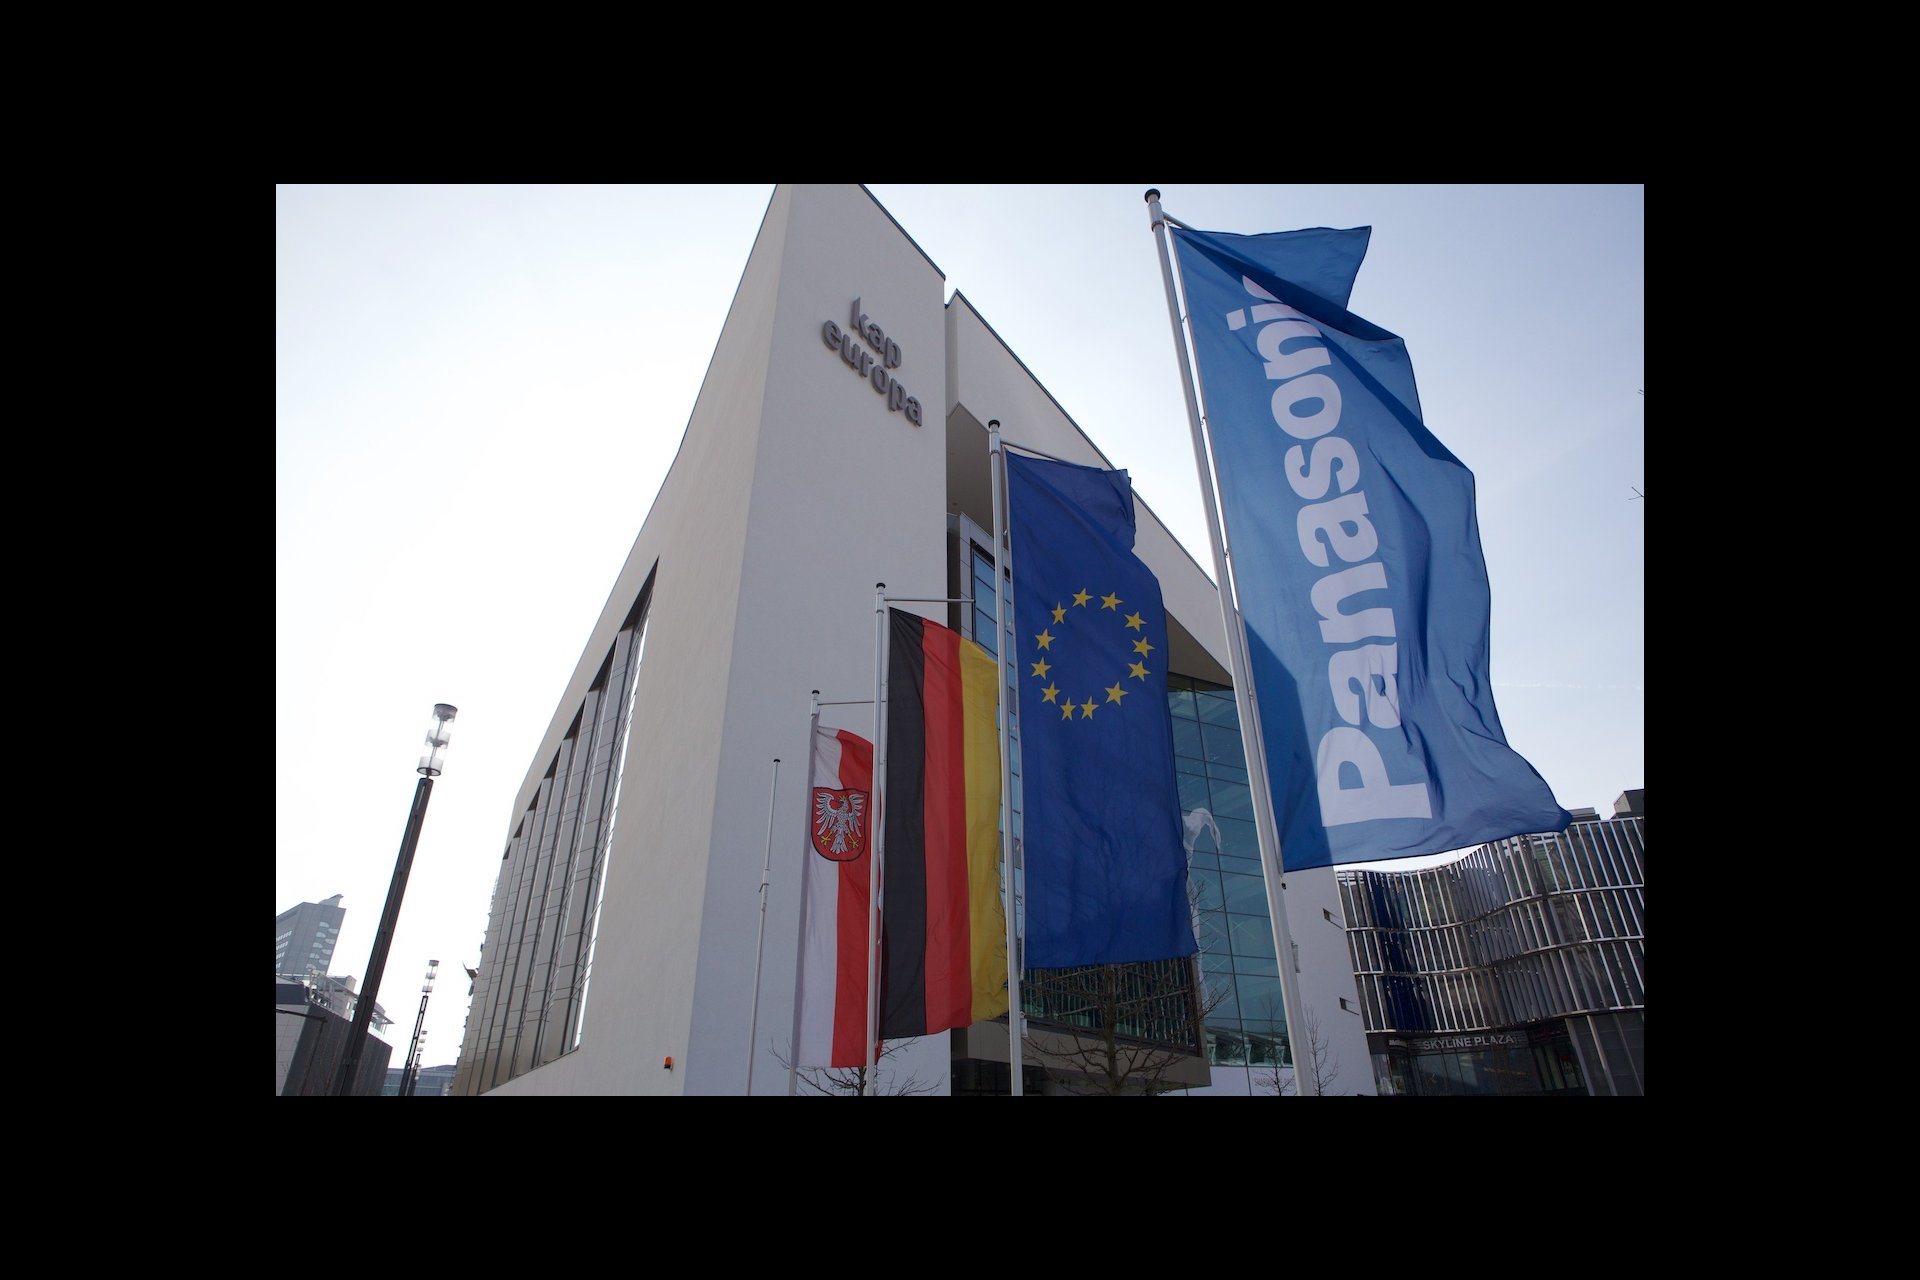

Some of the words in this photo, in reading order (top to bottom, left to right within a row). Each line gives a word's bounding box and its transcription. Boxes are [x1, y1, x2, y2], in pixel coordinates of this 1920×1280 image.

[851, 297, 901, 369] kap
[822, 320, 922, 427] europa
[1423, 1037, 1472, 1050] SKYLINE
[1474, 1034, 1514, 1046] PLAZA
